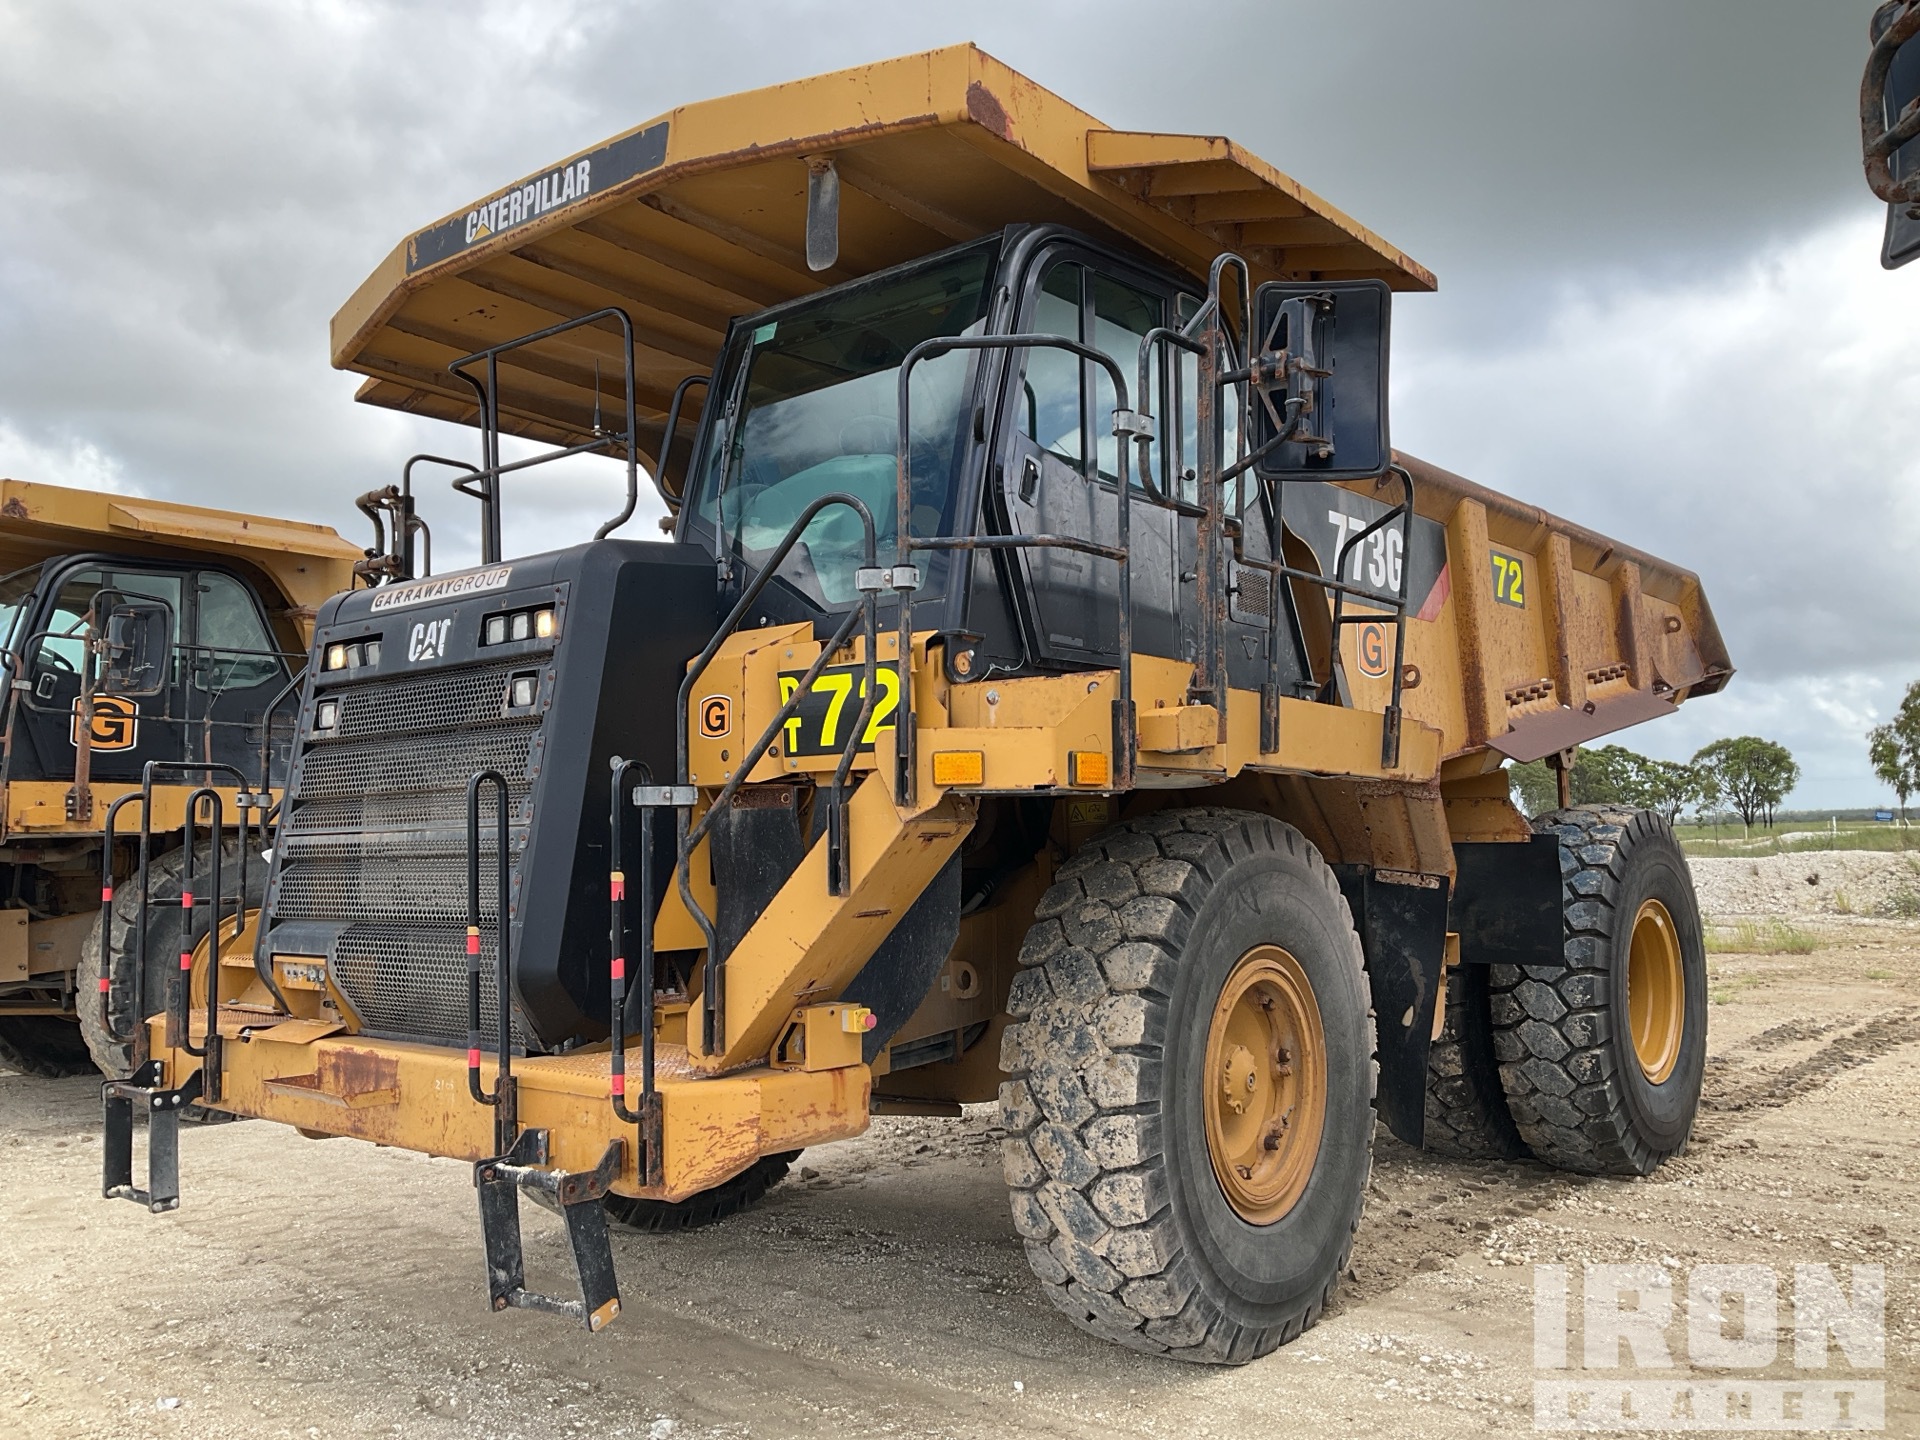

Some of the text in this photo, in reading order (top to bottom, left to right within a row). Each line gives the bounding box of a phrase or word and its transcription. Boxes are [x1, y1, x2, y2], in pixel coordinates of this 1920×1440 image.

[465, 160, 591, 244] CATERPILLAR
[1328, 510, 1404, 592] 773G
[1493, 556, 1523, 604] 72
[408, 618, 451, 662] CAT
[1362, 625, 1383, 668] G
[91, 702, 125, 743] G
[704, 701, 726, 732] G
[811, 668, 899, 747] 72
